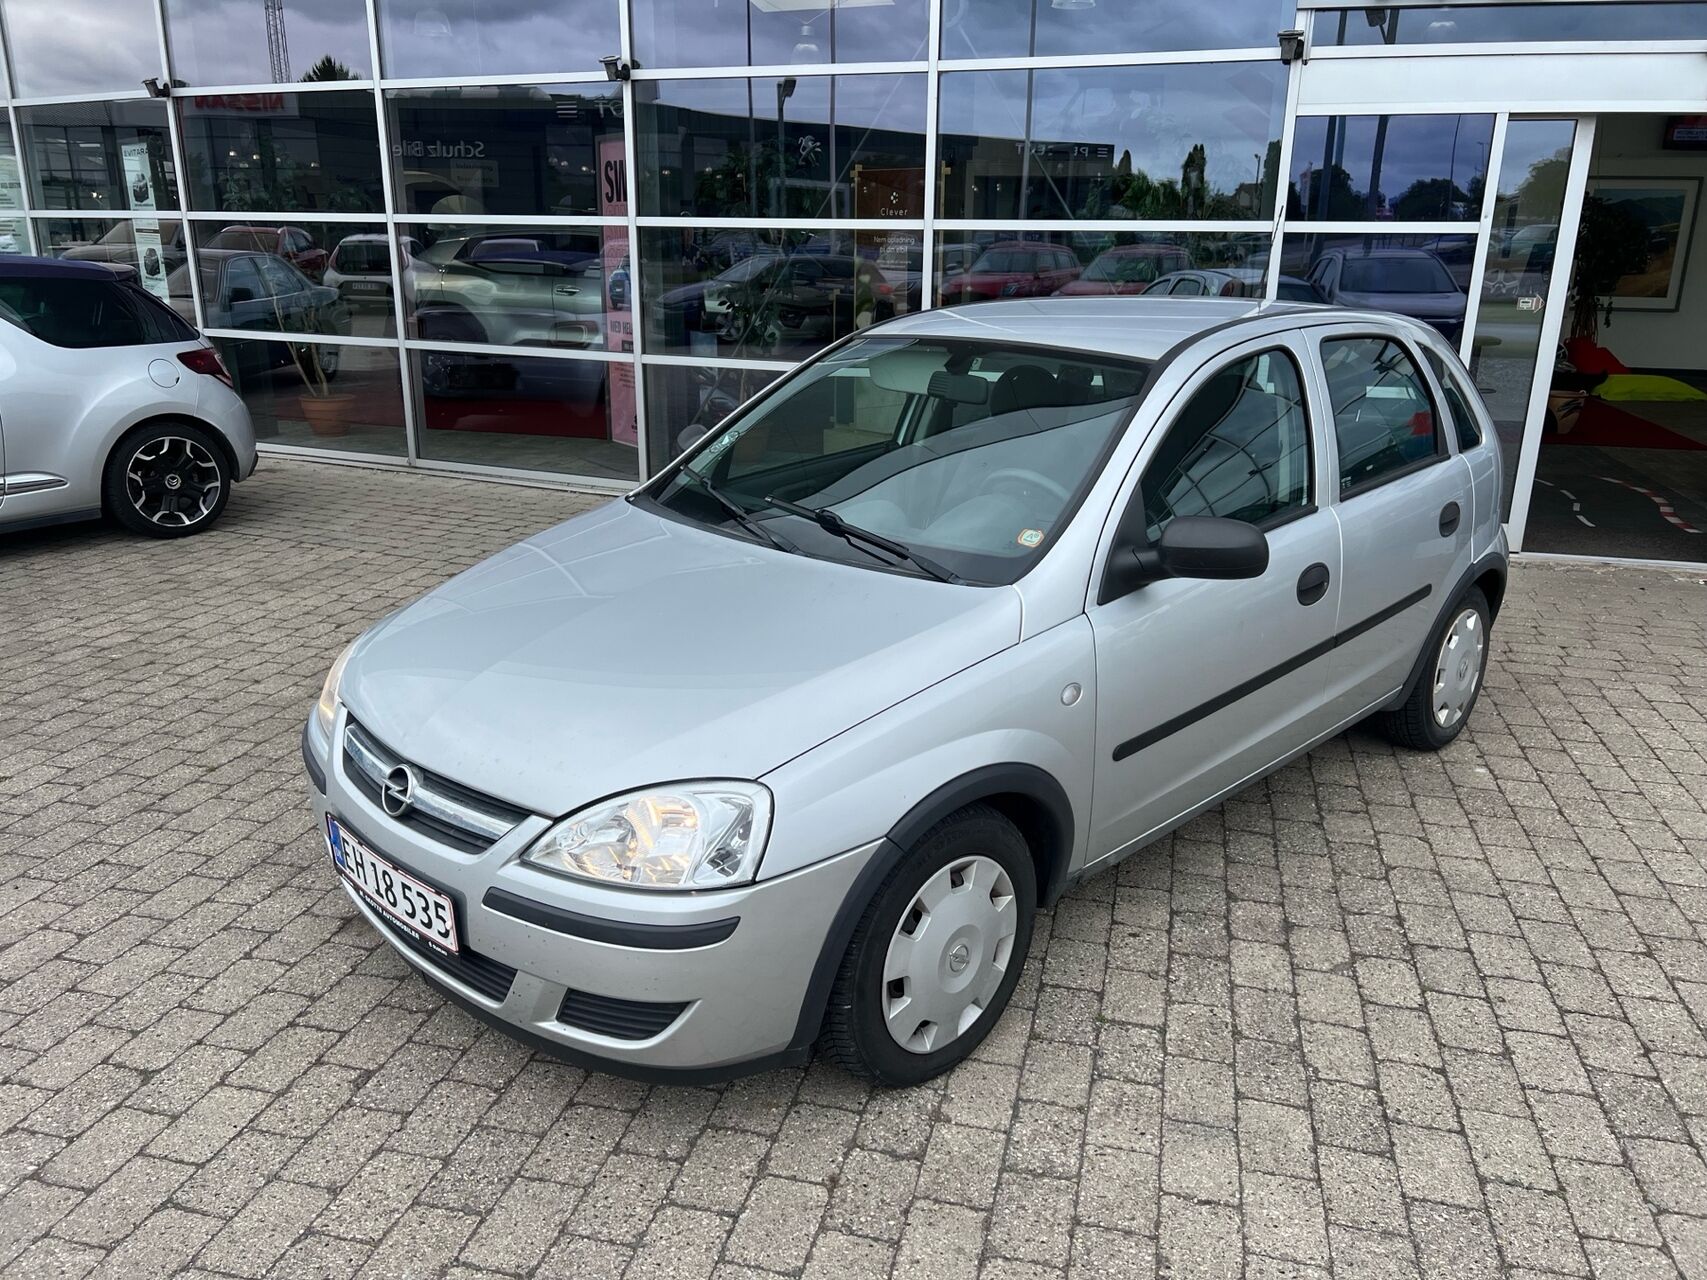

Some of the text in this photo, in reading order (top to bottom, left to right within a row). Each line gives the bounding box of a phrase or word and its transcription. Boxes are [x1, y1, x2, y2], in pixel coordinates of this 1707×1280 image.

[880, 207, 908, 216] Clever
[342, 837, 368, 886] EH
[370, 861, 398, 908] 18
[400, 880, 451, 939] 535
